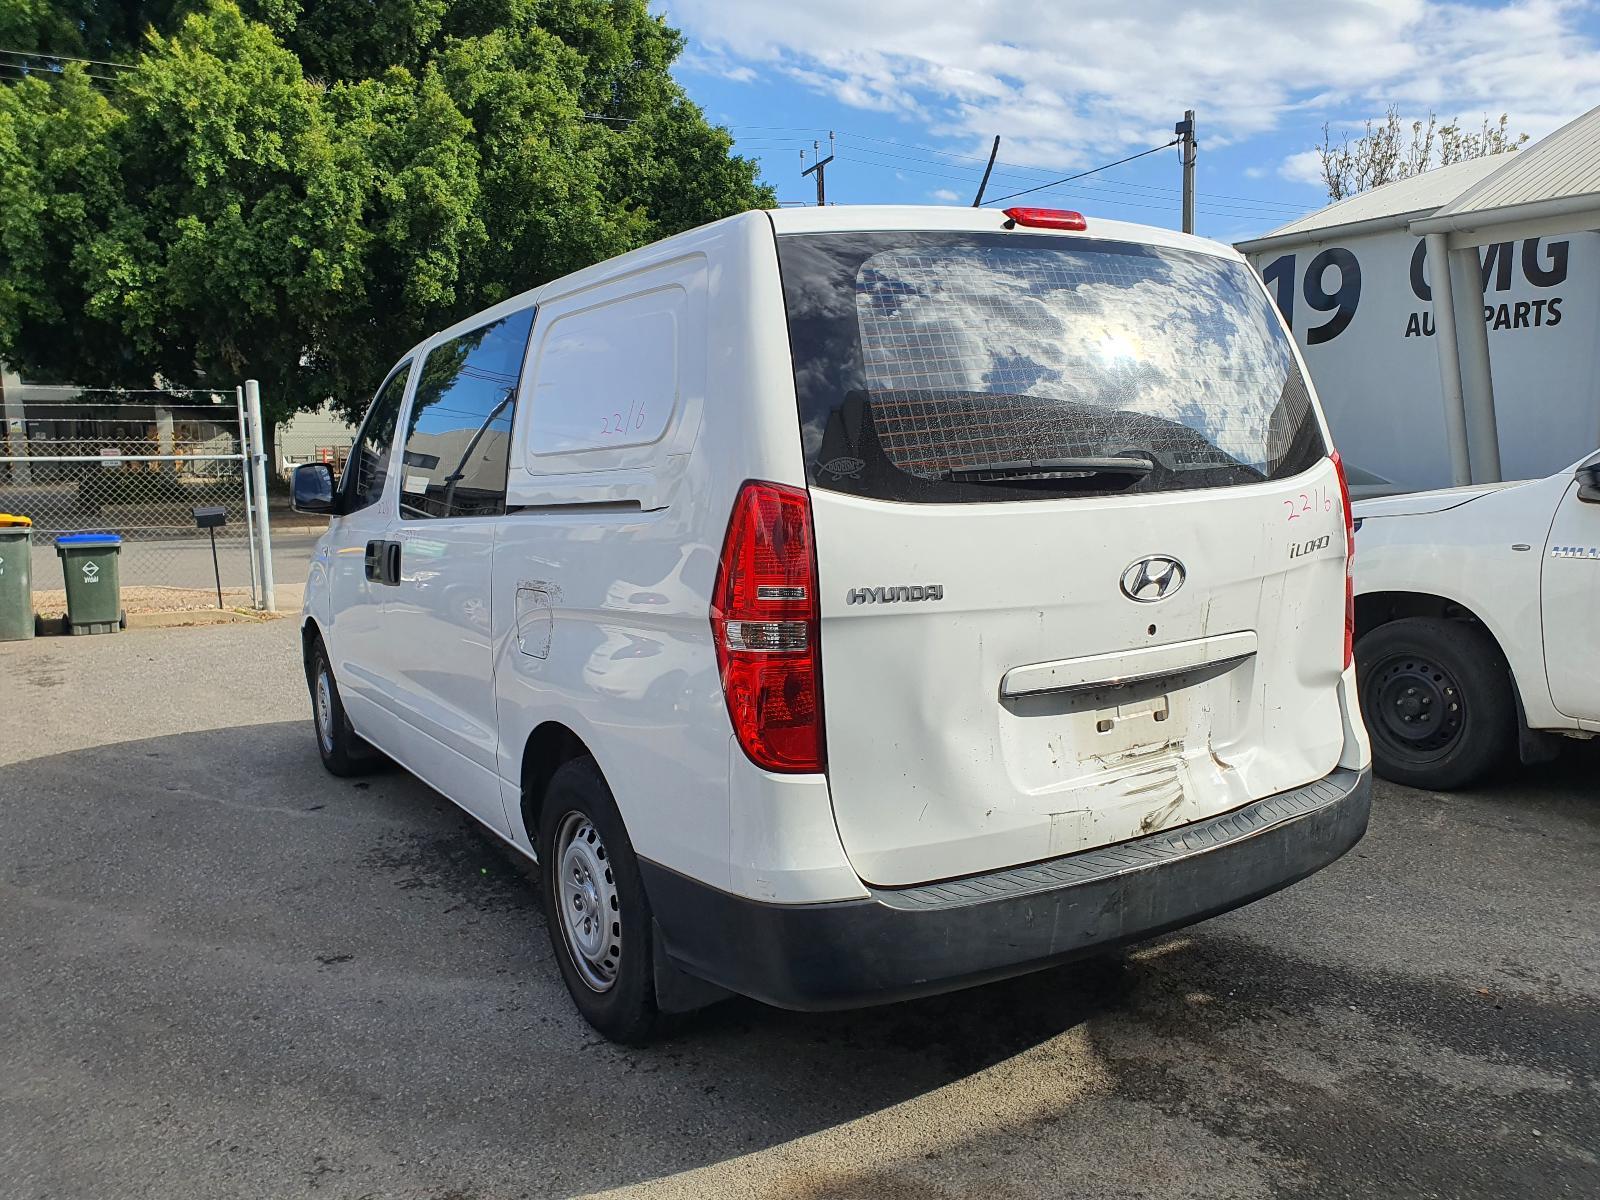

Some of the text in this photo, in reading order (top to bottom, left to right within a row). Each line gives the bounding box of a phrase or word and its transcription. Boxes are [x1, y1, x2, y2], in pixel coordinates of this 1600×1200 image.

[1262, 247, 1362, 346] 19
[1483, 297, 1564, 331] PARTS
[845, 584, 944, 606] HYUNDAI
